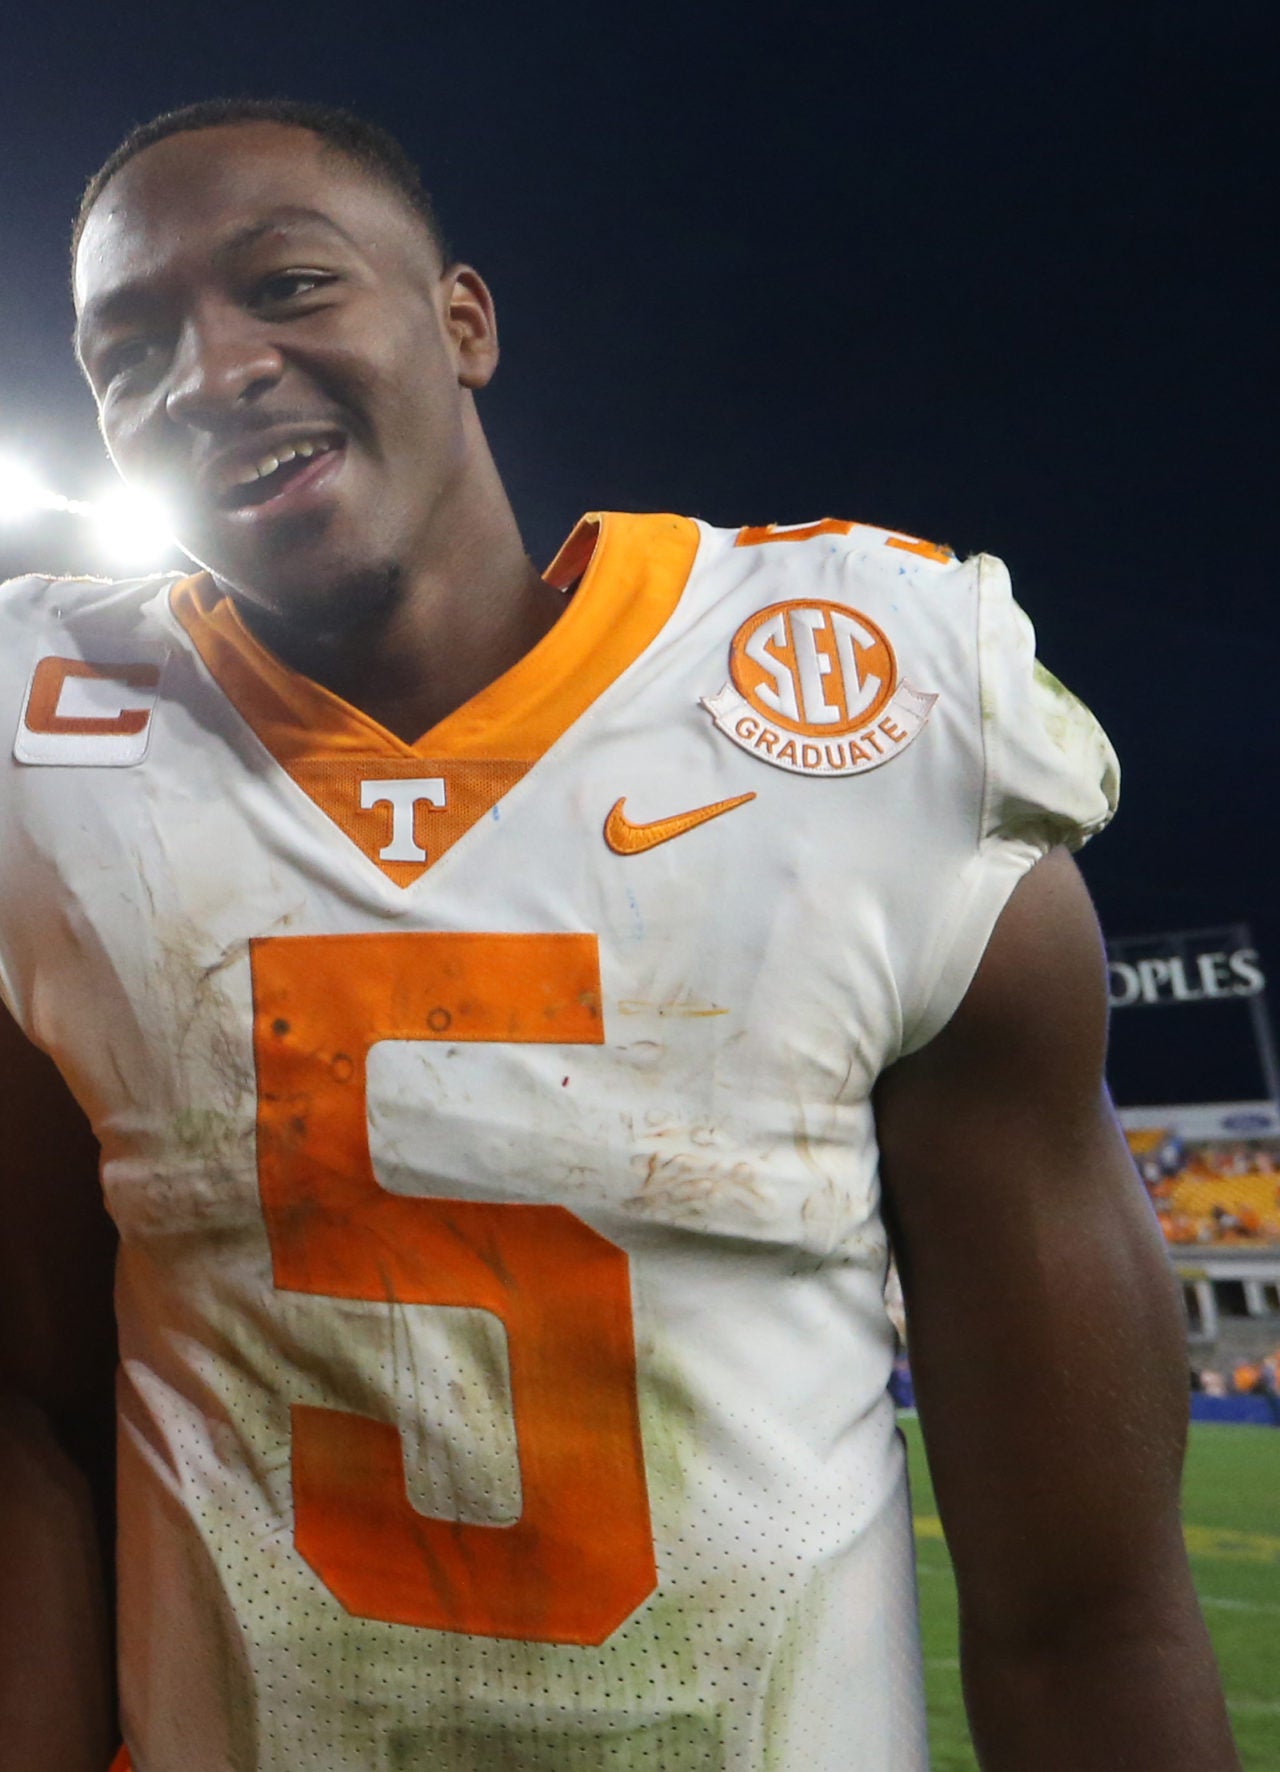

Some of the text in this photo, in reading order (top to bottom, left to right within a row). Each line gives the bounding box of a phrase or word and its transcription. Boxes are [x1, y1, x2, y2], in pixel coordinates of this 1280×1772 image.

[25, 656, 161, 736] C
[745, 608, 881, 725] SEC
[735, 716, 908, 769] GRADUATE
[359, 777, 448, 862] T
[1108, 948, 1266, 1008] OPLES
[249, 931, 658, 1646] 5
